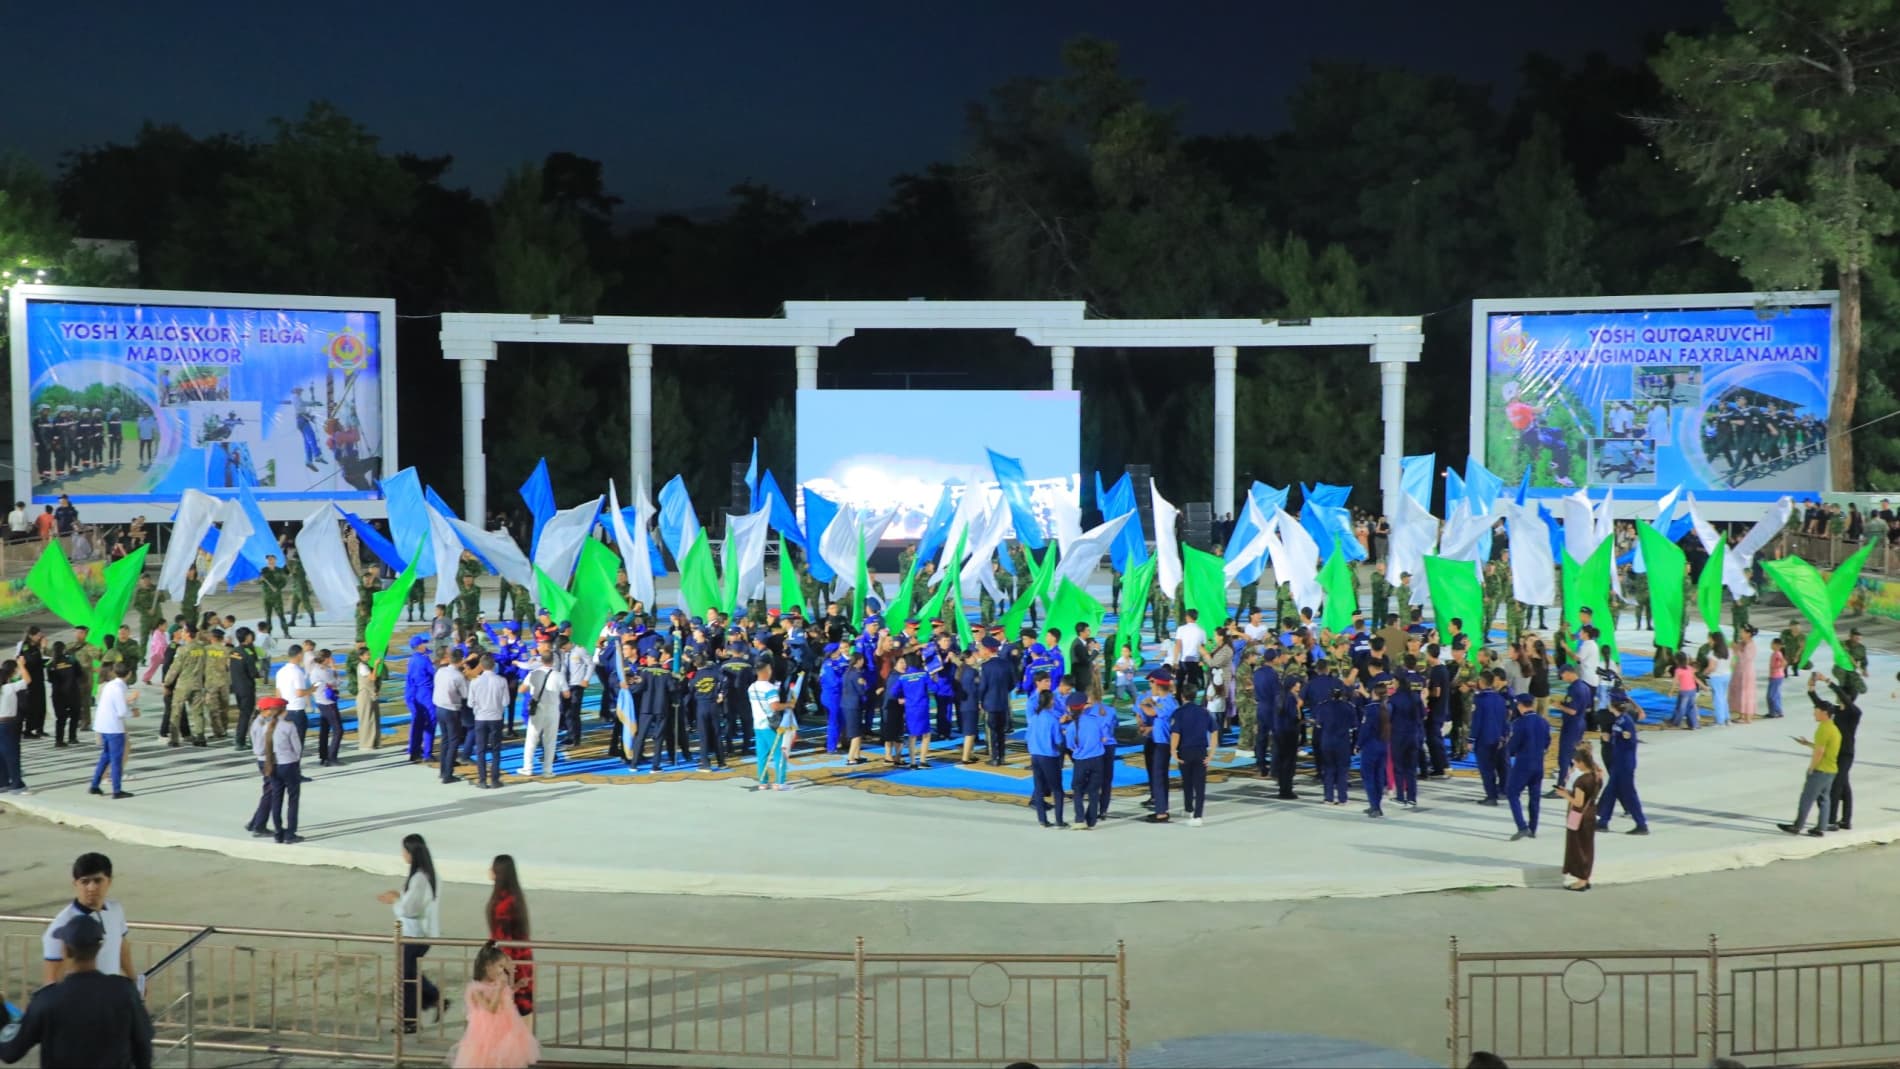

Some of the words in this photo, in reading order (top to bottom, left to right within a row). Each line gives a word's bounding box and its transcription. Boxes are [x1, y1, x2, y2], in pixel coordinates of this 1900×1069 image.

[61, 323, 117, 340] YOSH
[125, 325, 231, 342] XALOSKOR
[259, 328, 305, 344] ELGA
[1589, 328, 1635, 343] YOSH
[1642, 327, 1771, 343] QUTQARUVCHI
[127, 346, 241, 362] MADADKOR
[1680, 346, 1818, 362] FAXRLANAMAN
